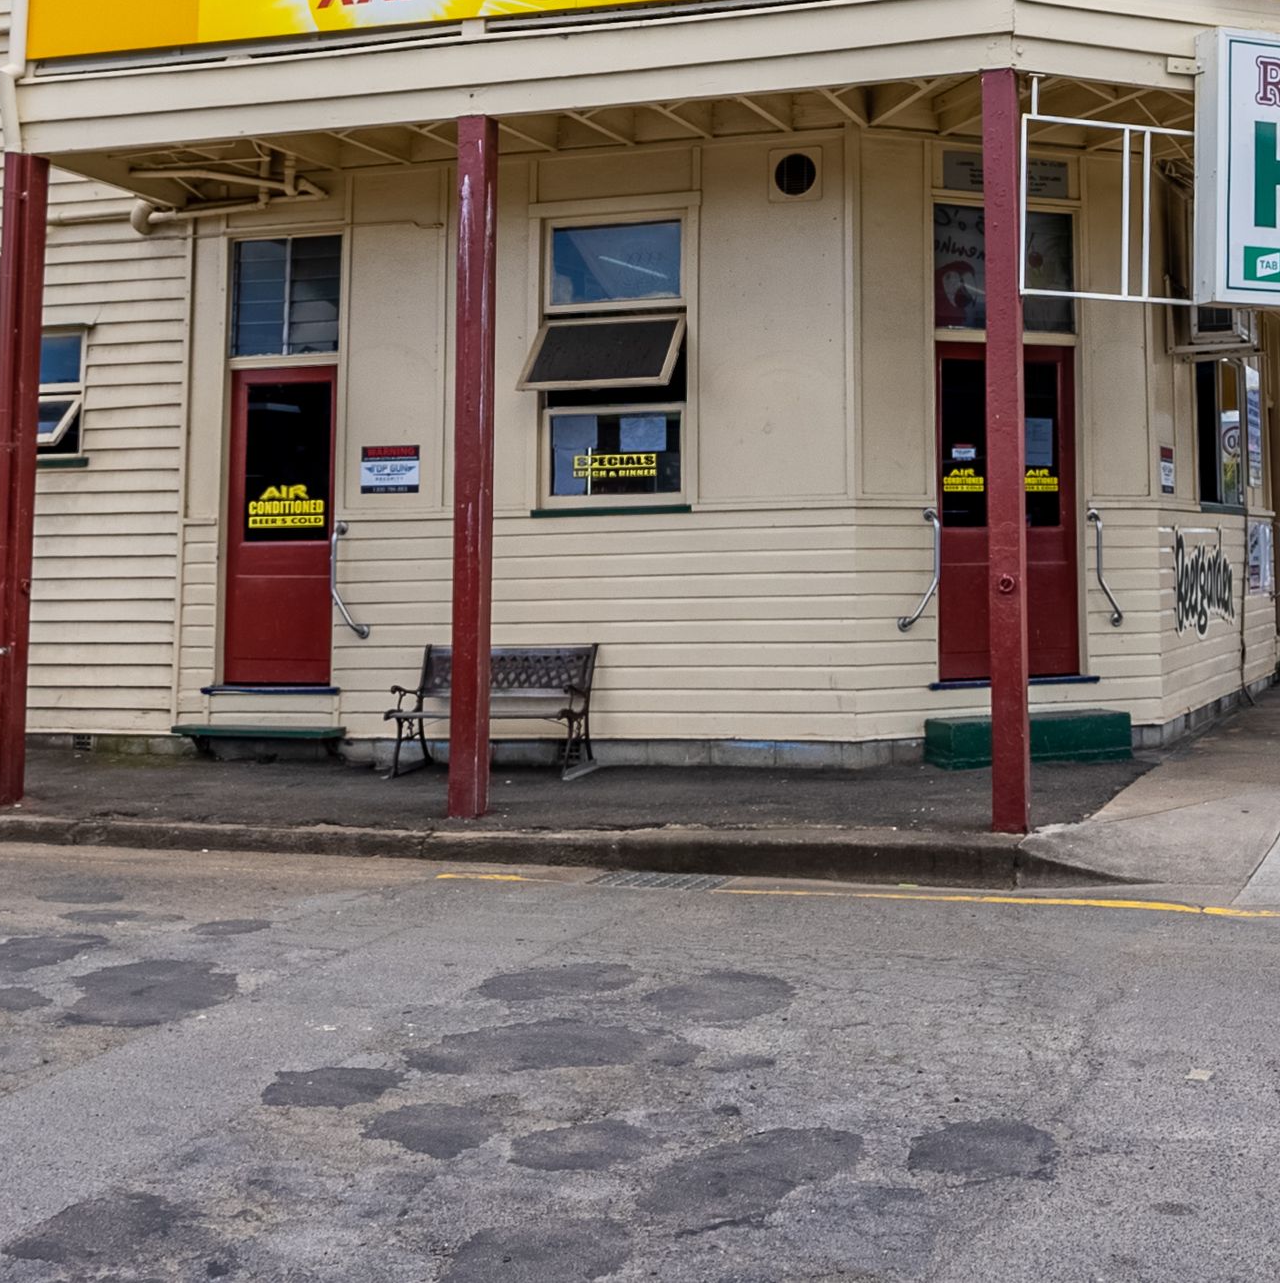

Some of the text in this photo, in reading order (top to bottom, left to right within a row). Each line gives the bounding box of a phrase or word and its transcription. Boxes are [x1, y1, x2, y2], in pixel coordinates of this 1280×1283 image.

[1259, 259, 1279, 271] TAB
[576, 455, 655, 466] SPECIALS
[619, 469, 657, 477] DINNER
[950, 468, 975, 476] AIR
[259, 483, 309, 500] AIR
[248, 499, 325, 515] CONDITIONED
[290, 516, 322, 525] COLD
